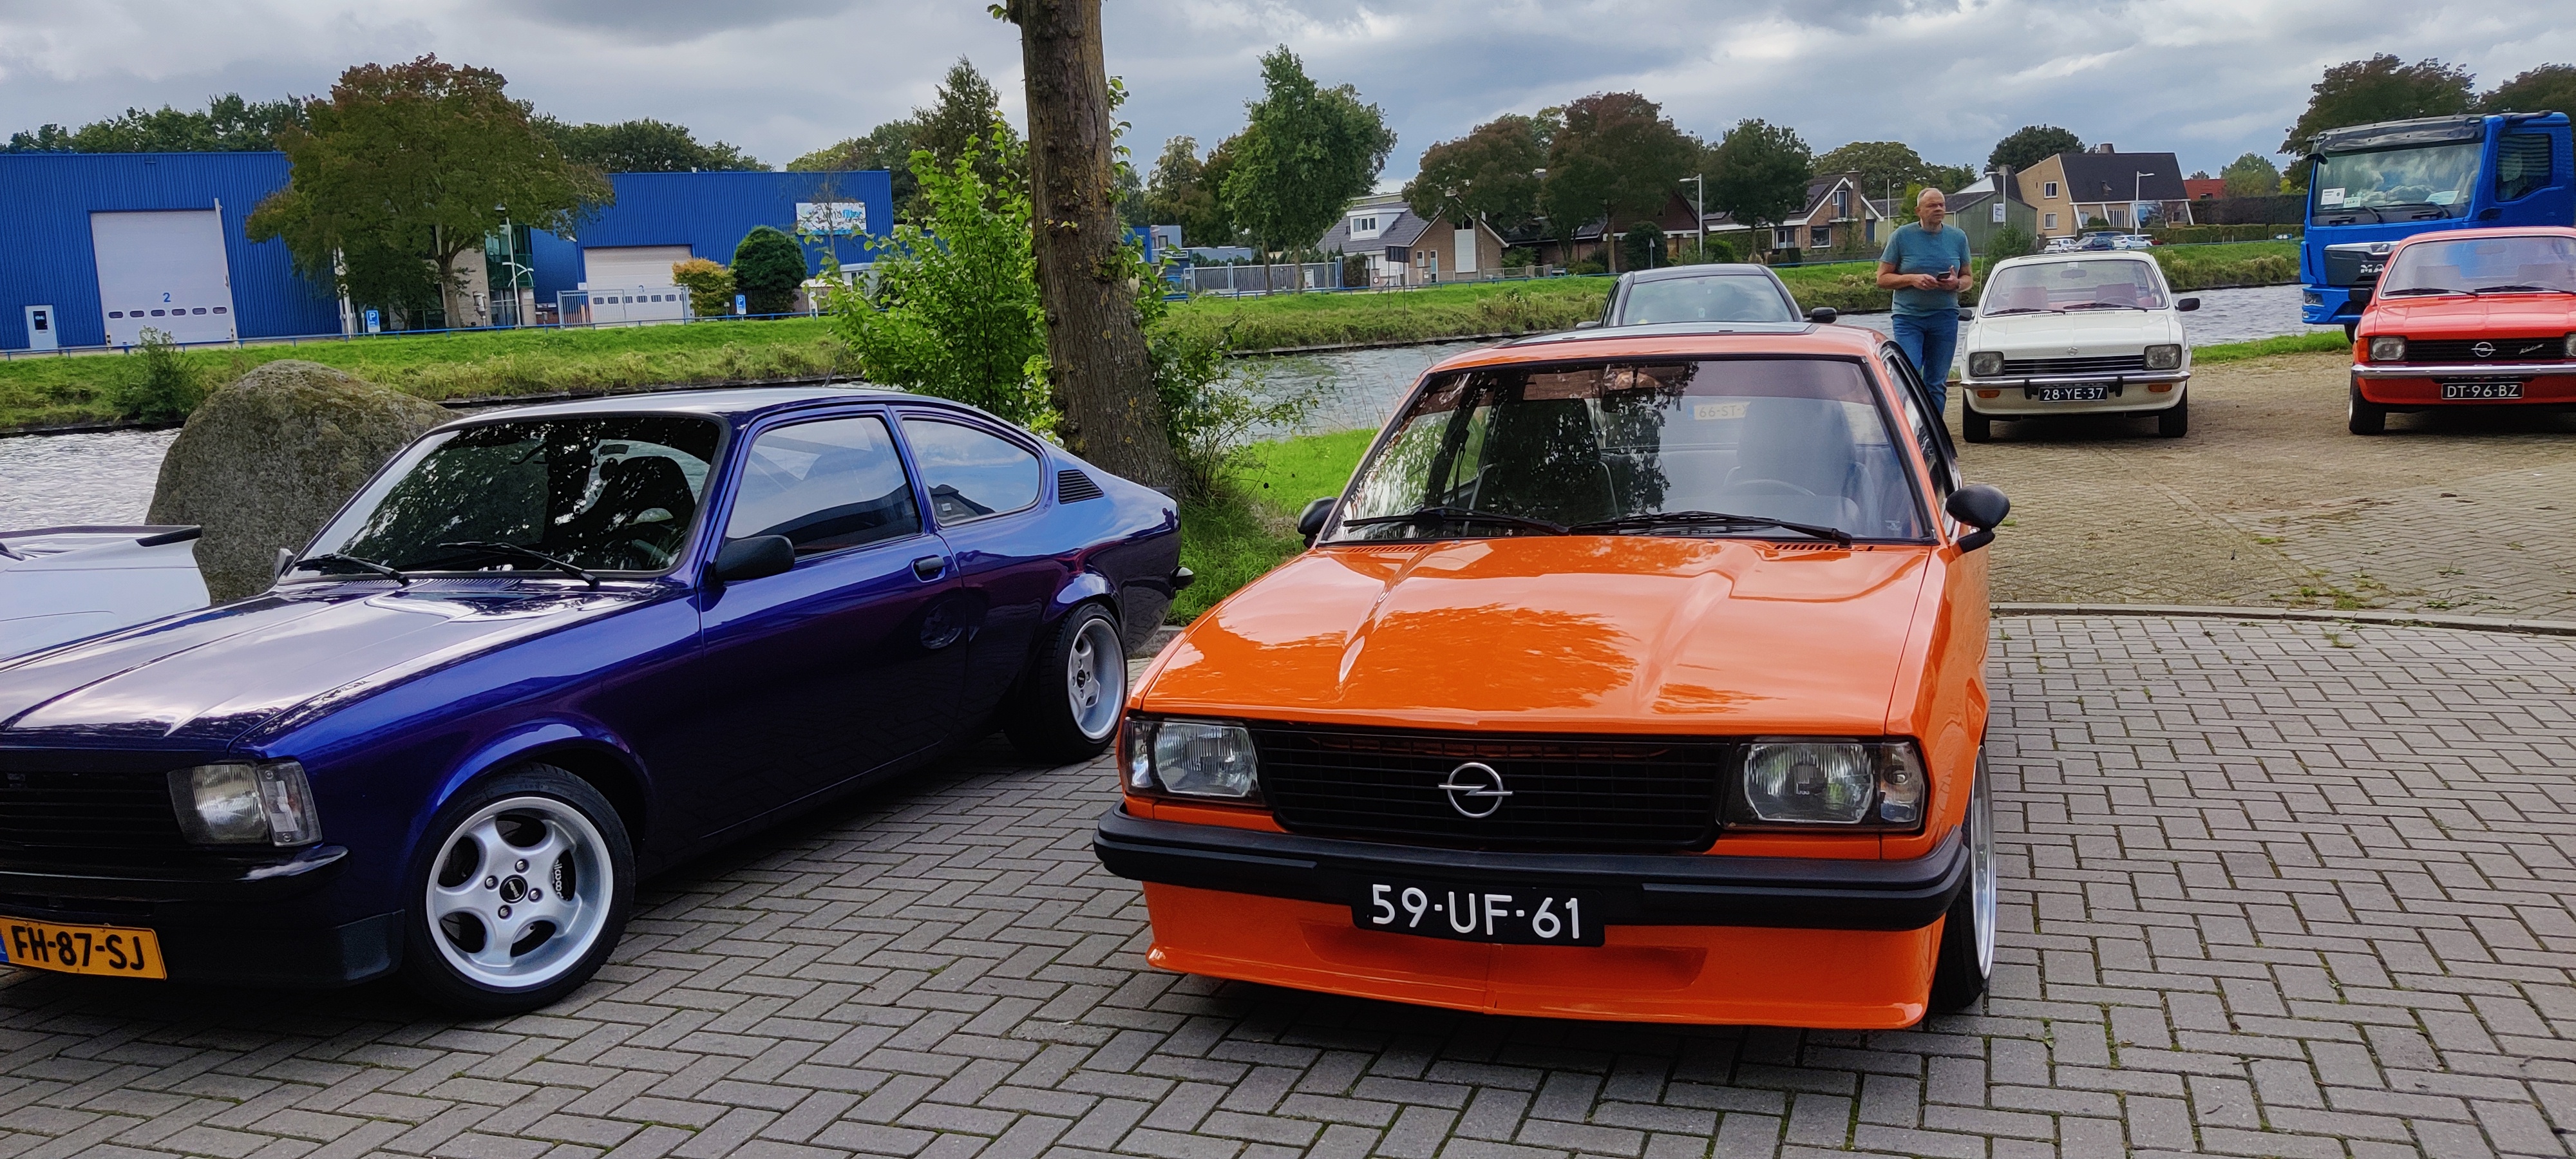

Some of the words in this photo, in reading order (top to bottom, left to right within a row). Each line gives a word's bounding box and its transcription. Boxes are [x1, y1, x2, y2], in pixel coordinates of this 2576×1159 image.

[2360, 264, 2385, 273] MA
[163, 292, 171, 303] 2
[369, 312, 376, 321] P
[2043, 388, 2104, 400] 28-YE-37
[2447, 385, 2519, 397] DT-96-BZ
[1699, 404, 1747, 417] 66-ST-X
[1372, 883, 1580, 939] 59-UF-61
[11, 925, 145, 970] FH-87-SJ
